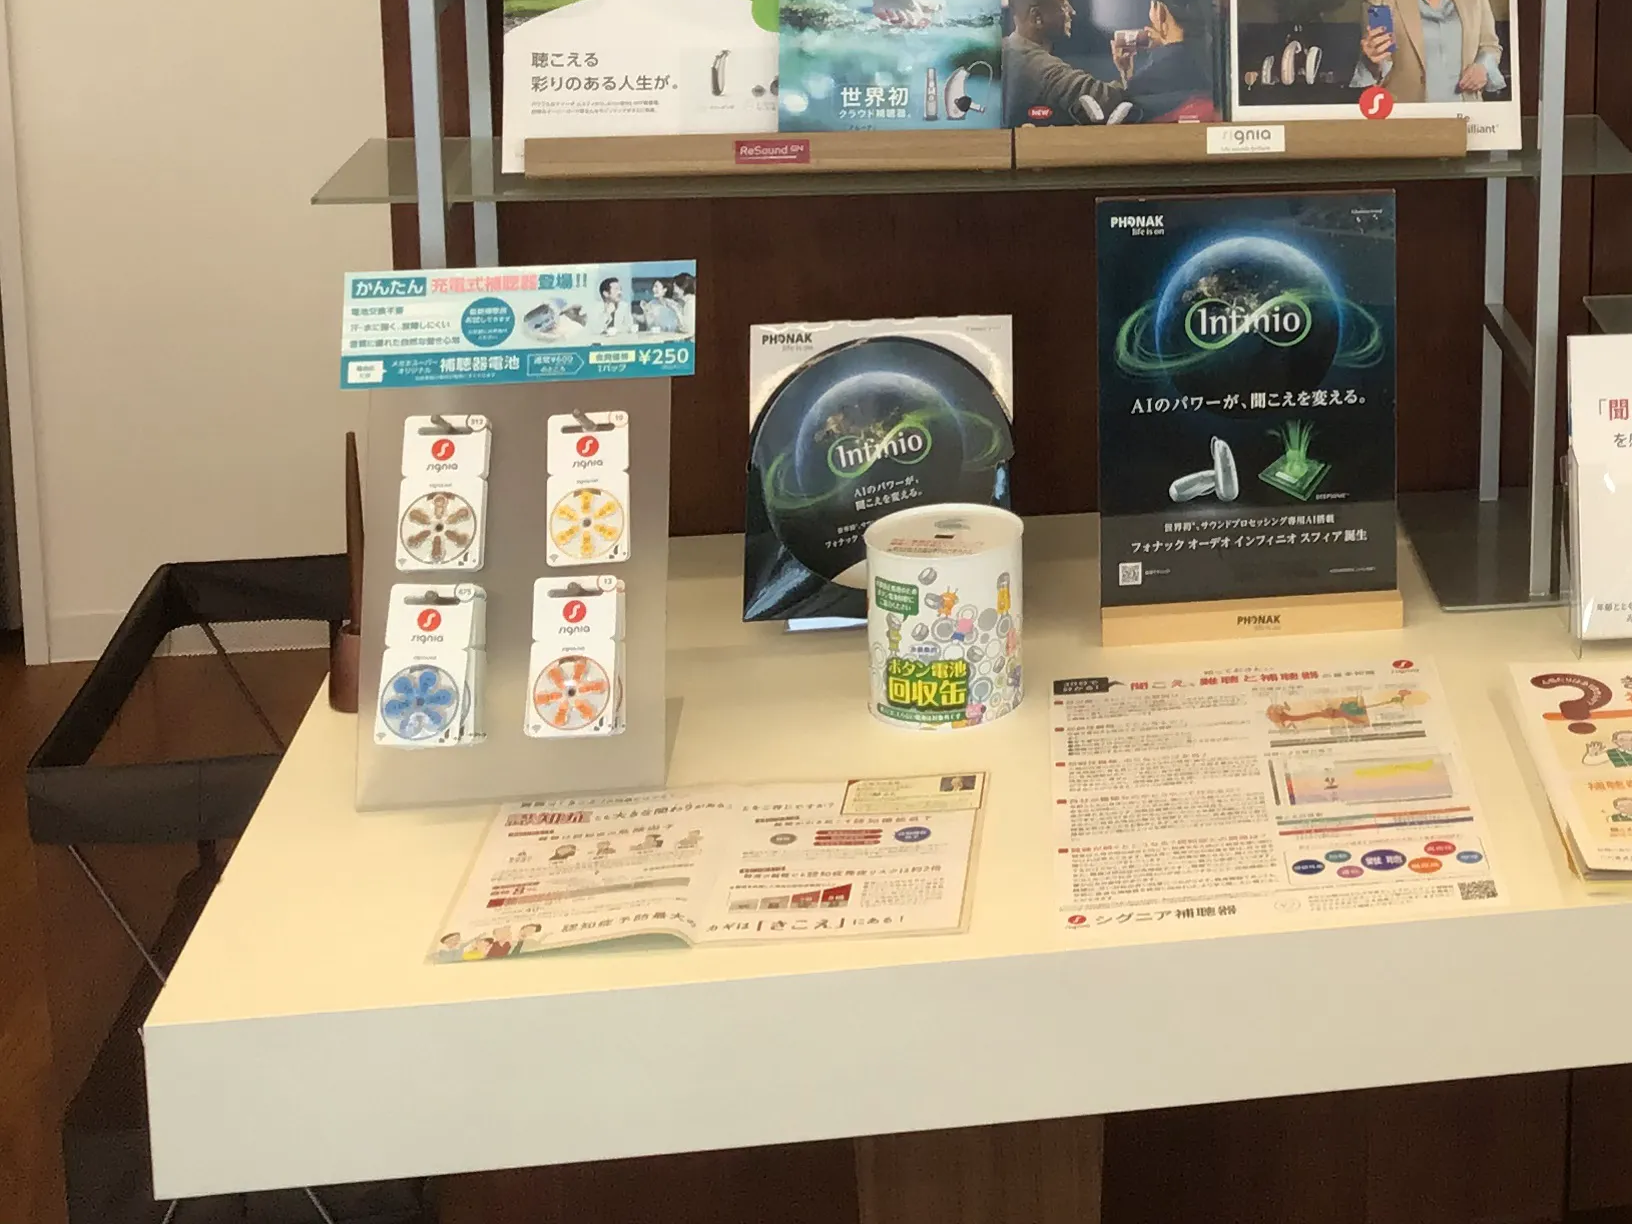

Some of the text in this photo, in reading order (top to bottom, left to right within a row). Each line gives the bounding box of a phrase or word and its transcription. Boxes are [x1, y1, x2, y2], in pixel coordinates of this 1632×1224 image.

[531, 52, 599, 68] 聴こえる
[531, 75, 678, 92] 彩りのある人生が。
[840, 86, 910, 107] 世界初
[740, 145, 788, 156] ReSound
[1111, 215, 1164, 229] PHONAK
[355, 279, 424, 296] かんたん
[1199, 308, 1300, 336] Infinio
[762, 332, 813, 346] PHONAK
[440, 355, 520, 373] 補聴器電池
[639, 347, 689, 366] ¥250
[1131, 389, 1368, 415] AIのパワーが、聞こえを変える。
[835, 428, 924, 469] Infinio
[426, 462, 458, 473] signia
[572, 459, 604, 470] signia
[1132, 537, 1184, 553] フォナック
[1189, 536, 1231, 550] オーデオ
[1234, 533, 1296, 548] インフィニオ
[1301, 531, 1342, 544] スフィア
[1237, 615, 1281, 626] PHONAK
[559, 624, 591, 636] signia
[411, 634, 444, 644] signia
[888, 660, 967, 679] ボタン電池
[888, 679, 966, 707] 回収缶
